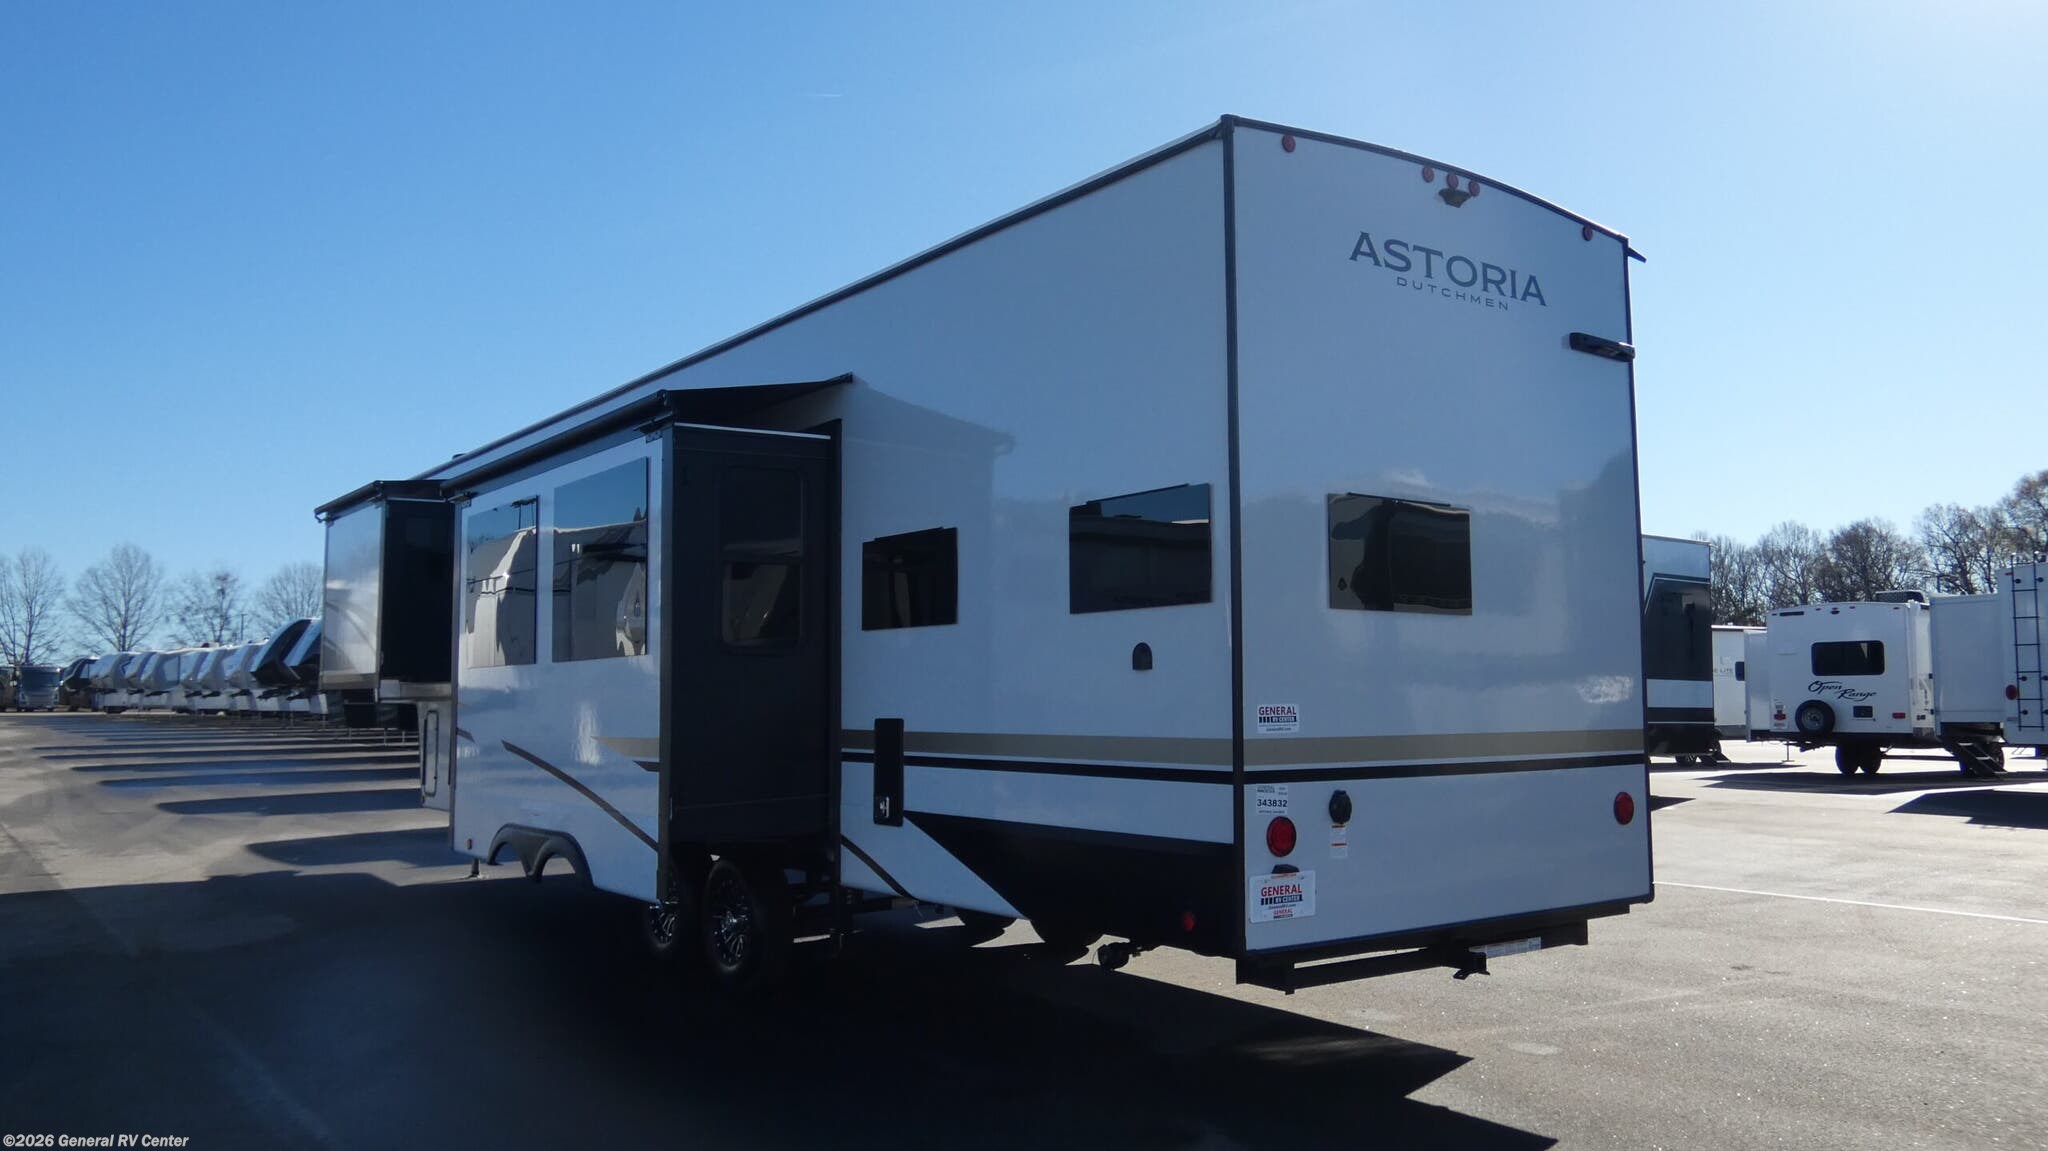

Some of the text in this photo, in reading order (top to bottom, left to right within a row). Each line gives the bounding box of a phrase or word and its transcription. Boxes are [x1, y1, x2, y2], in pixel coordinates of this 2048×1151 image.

[1348, 231, 1547, 307] ASTORIA
[1396, 276, 1509, 311] DUTCHMEN
[1808, 680, 1844, 695] Open
[1837, 687, 1878, 702] Range
[1258, 706, 1297, 716] GENERAL
[1257, 798, 1288, 808] 343832
[1260, 883, 1303, 897] GENERAL
